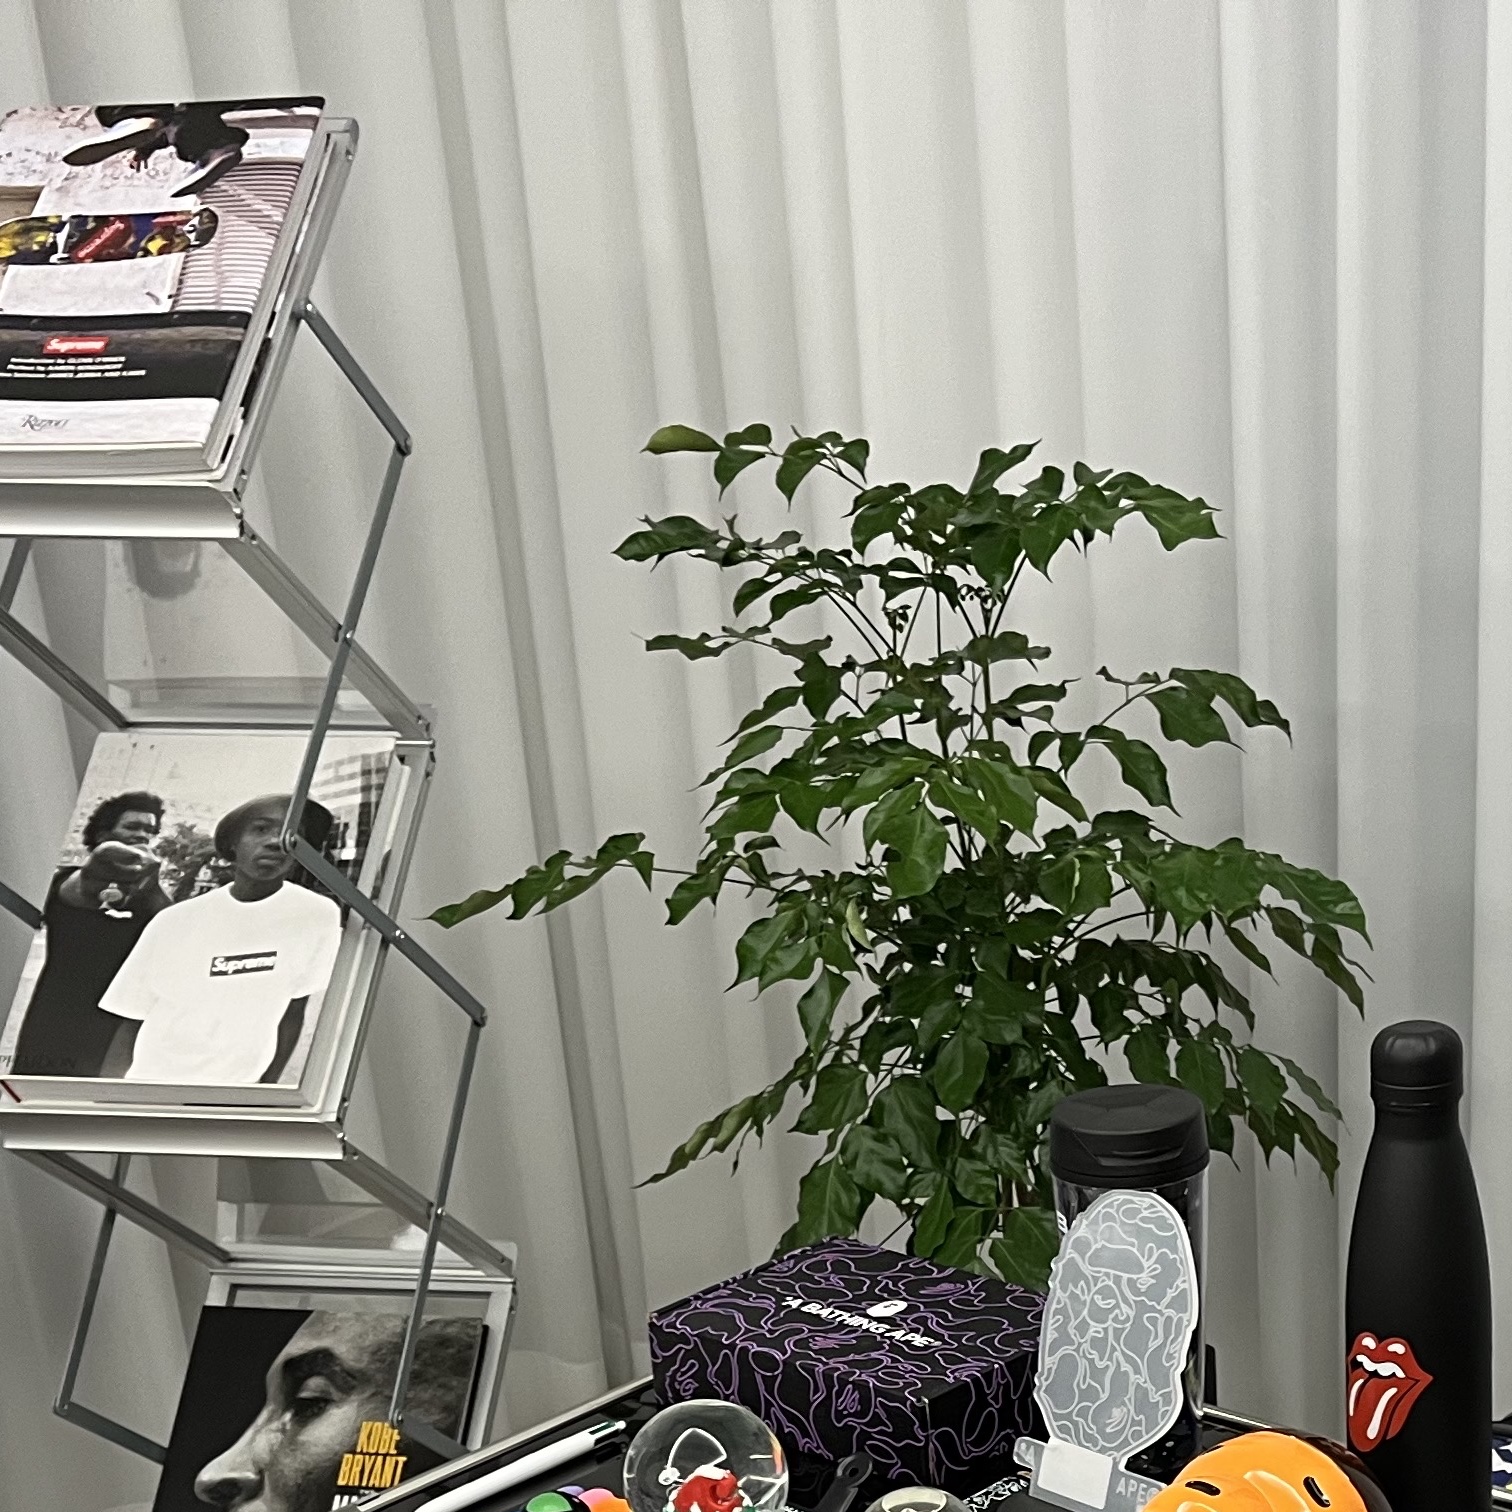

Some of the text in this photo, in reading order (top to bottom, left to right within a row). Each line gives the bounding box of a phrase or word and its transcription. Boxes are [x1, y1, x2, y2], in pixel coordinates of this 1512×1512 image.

[211, 956, 278, 975] Supreme
[800, 1302, 891, 1334] BATHING
[884, 1329, 937, 1348] APE
[355, 1421, 401, 1455] KOBE
[336, 1453, 408, 1488] BRYANT
